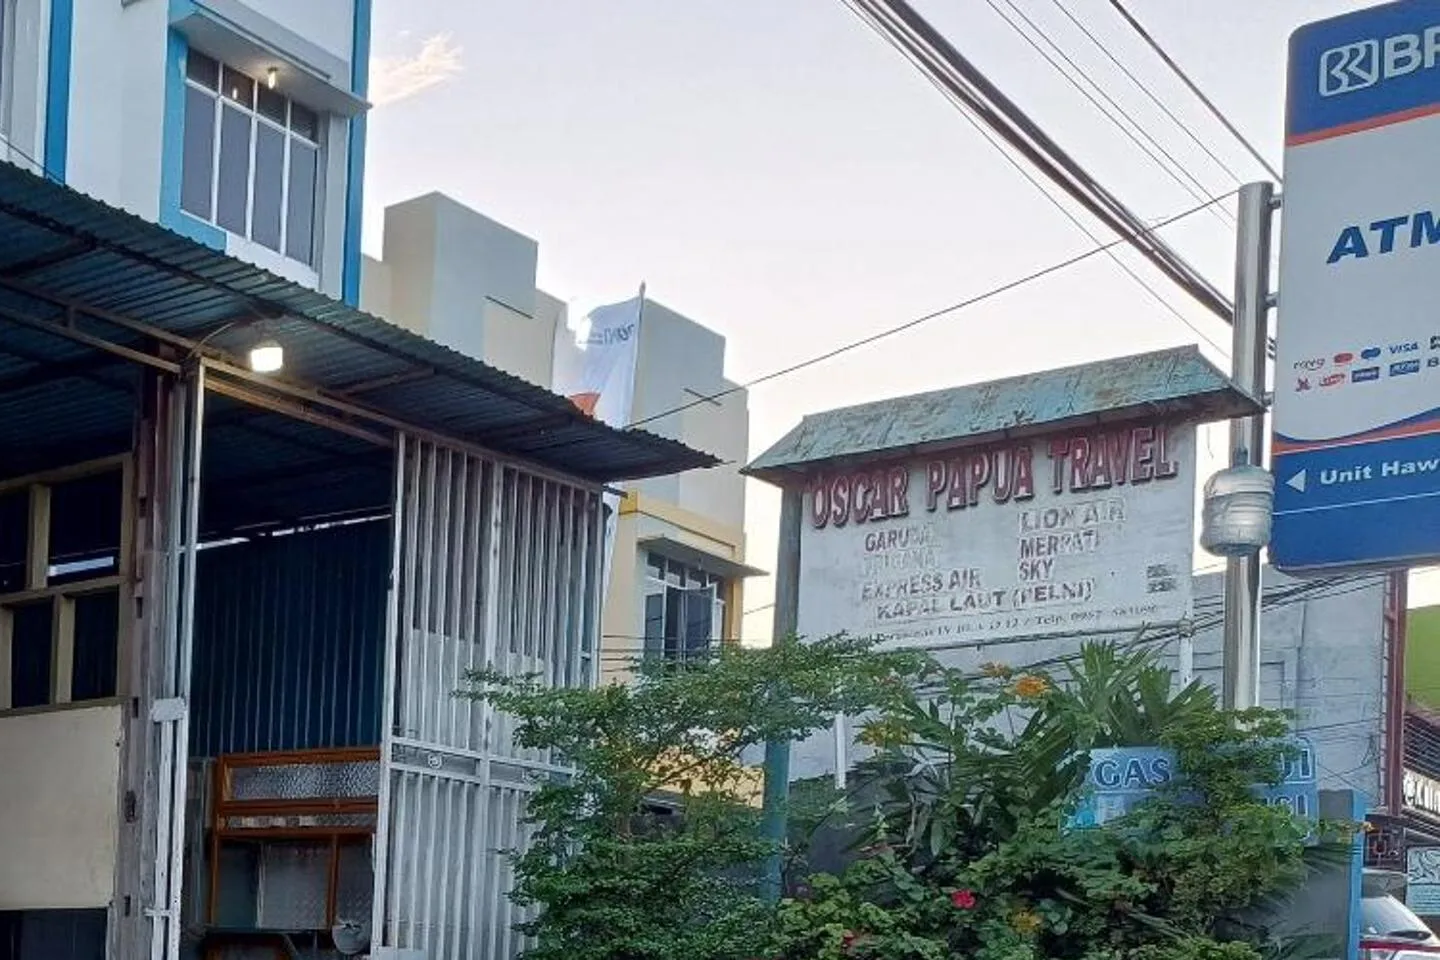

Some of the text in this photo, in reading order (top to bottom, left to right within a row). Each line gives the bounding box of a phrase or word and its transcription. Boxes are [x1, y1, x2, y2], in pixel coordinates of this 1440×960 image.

[1326, 211, 1440, 264] ATM
[808, 422, 1178, 529] OSCAR PAPUA TRAVEL
[1320, 464, 1372, 485] Unit
[1019, 558, 1053, 582] SKY
[950, 590, 1006, 611] LAUT
[1094, 757, 1171, 788] GAS
